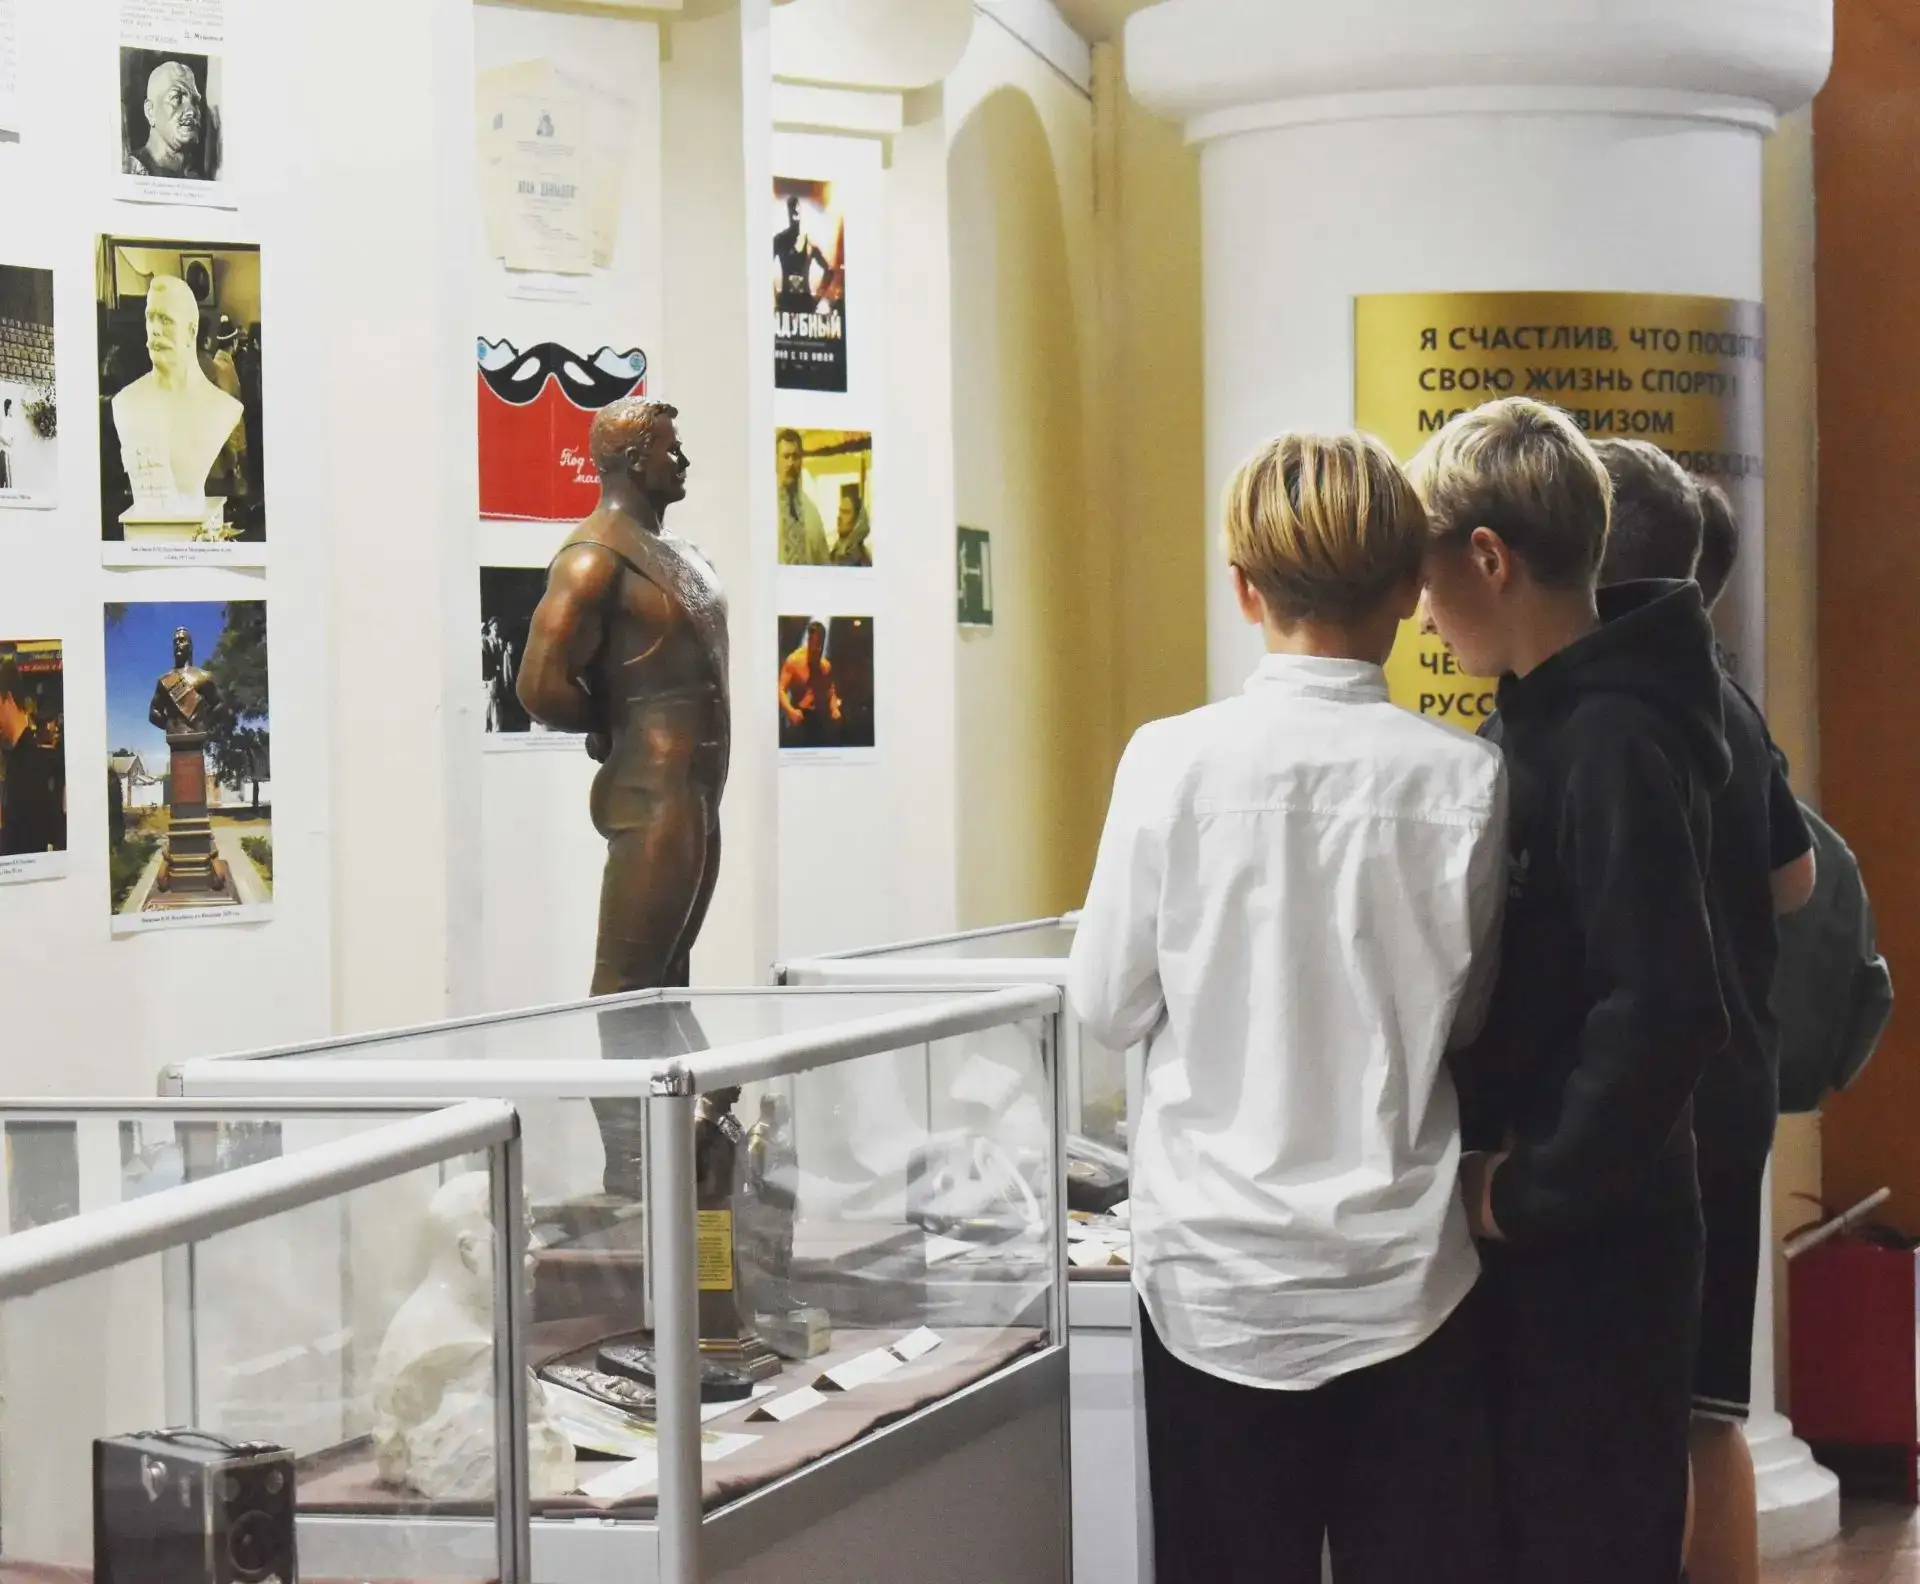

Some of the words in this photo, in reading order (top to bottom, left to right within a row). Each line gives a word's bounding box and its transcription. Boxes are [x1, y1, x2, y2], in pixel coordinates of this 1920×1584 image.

[1420, 328, 1437, 350] Я
[1449, 326, 1618, 352] СЧАСТЛИВ,
[1629, 328, 1680, 352] ЧТО
[1419, 368, 1514, 391] СВОЮ
[1525, 368, 1633, 391] ЖИЗНЬ
[1566, 408, 1675, 435] ВИЗОМ
[572, 473, 601, 484] мас
[1420, 652, 1465, 676] ЧЕ
[1420, 692, 1495, 716] РУСС
